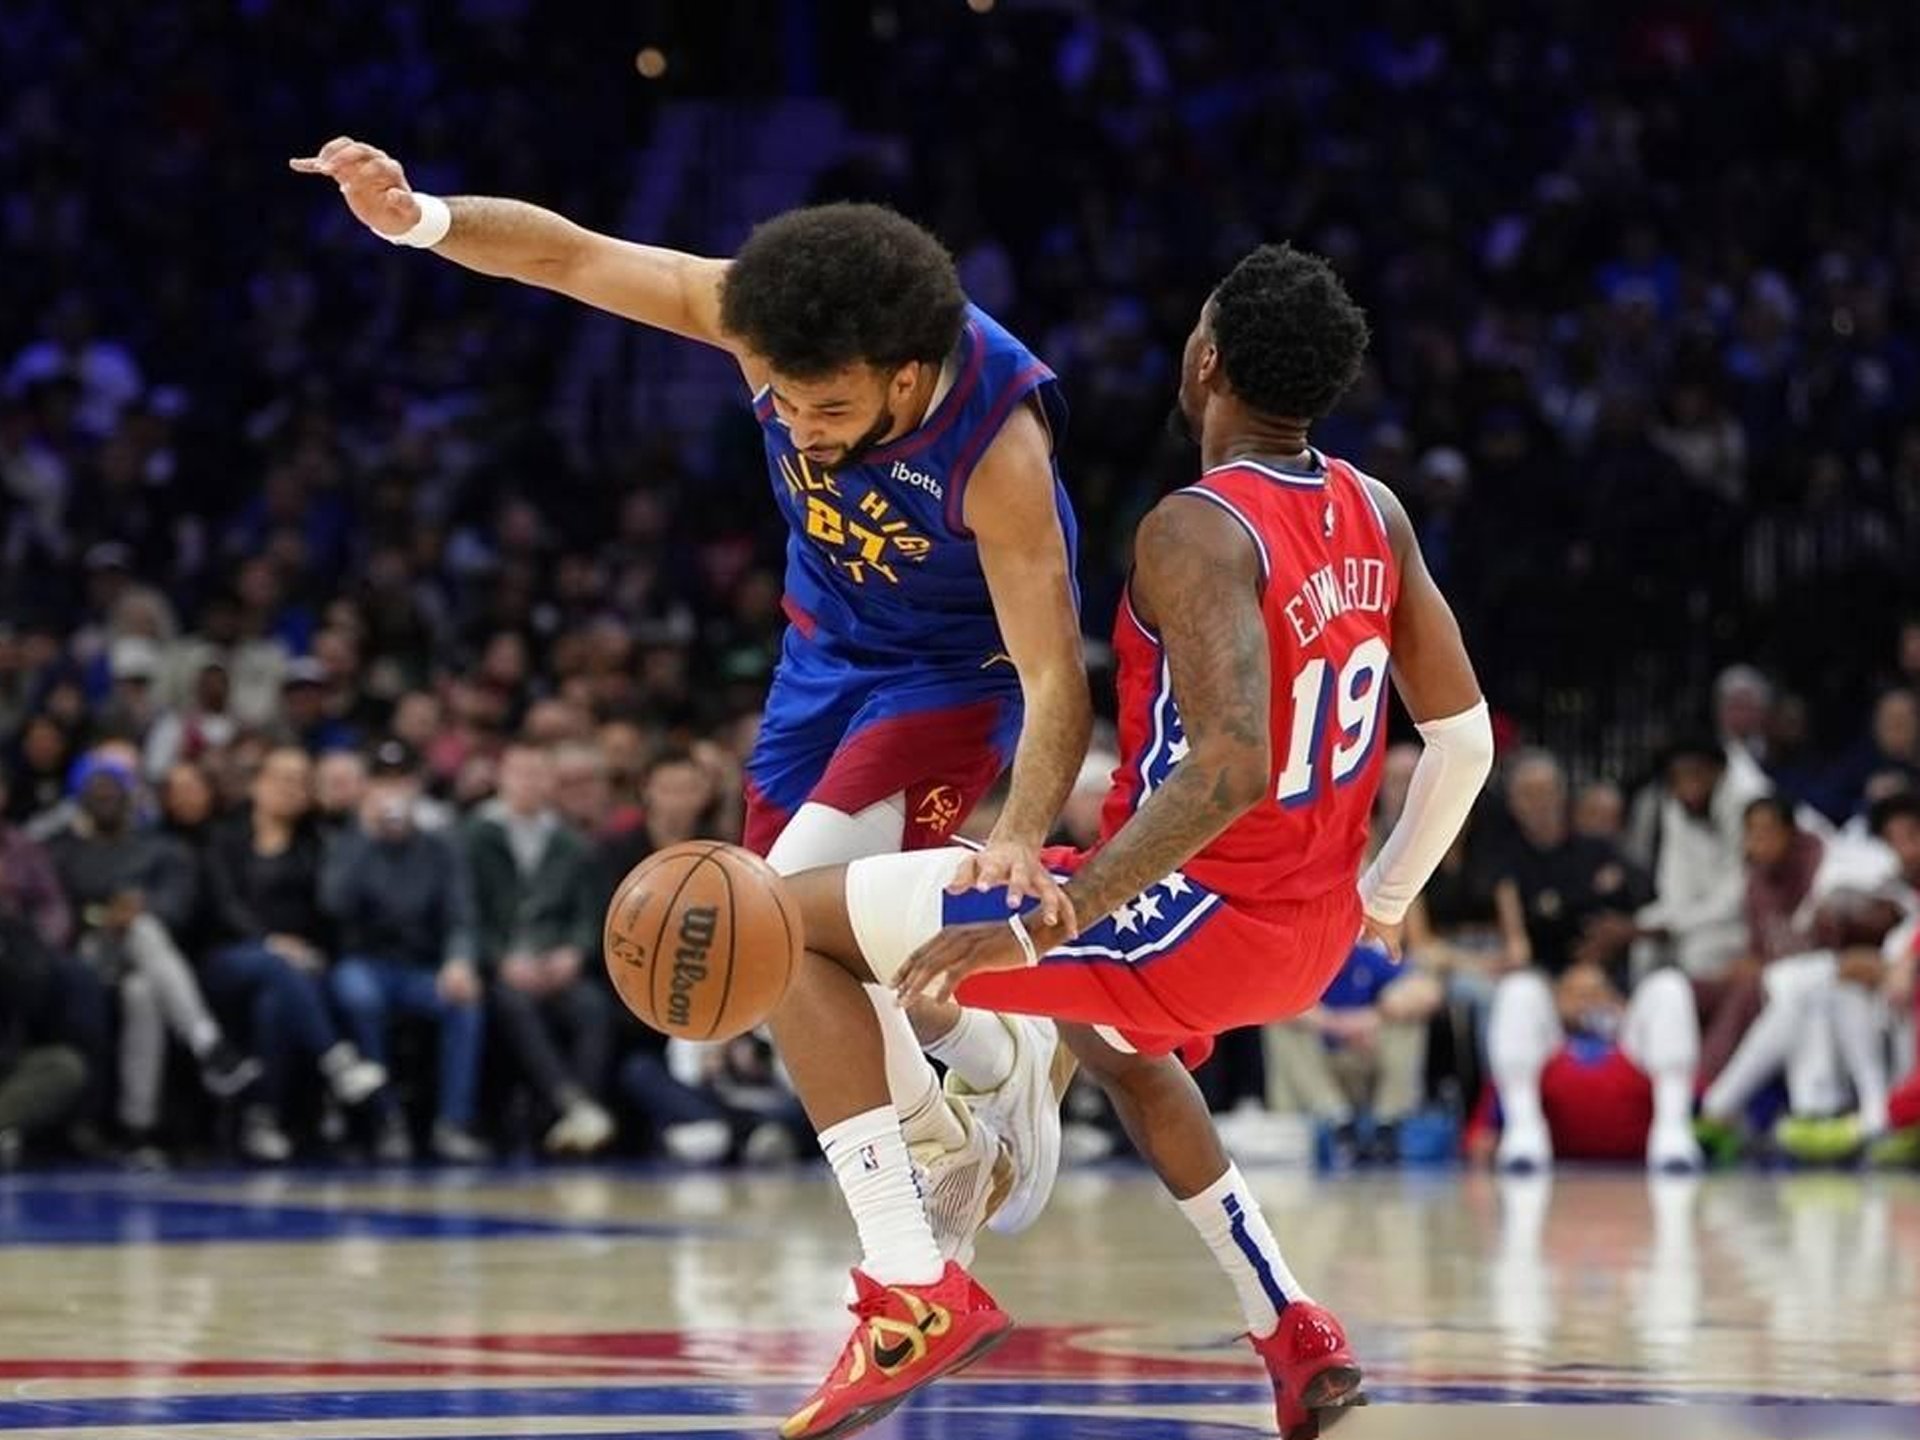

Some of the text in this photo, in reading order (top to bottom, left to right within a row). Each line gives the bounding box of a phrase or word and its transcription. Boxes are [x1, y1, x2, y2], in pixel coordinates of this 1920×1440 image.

[891, 461, 943, 500] ibotta
[807, 496, 886, 563] 27
[1284, 557, 1391, 647] EDWRD
[1277, 636, 1390, 803] 19
[668, 905, 719, 1027] Wilson
